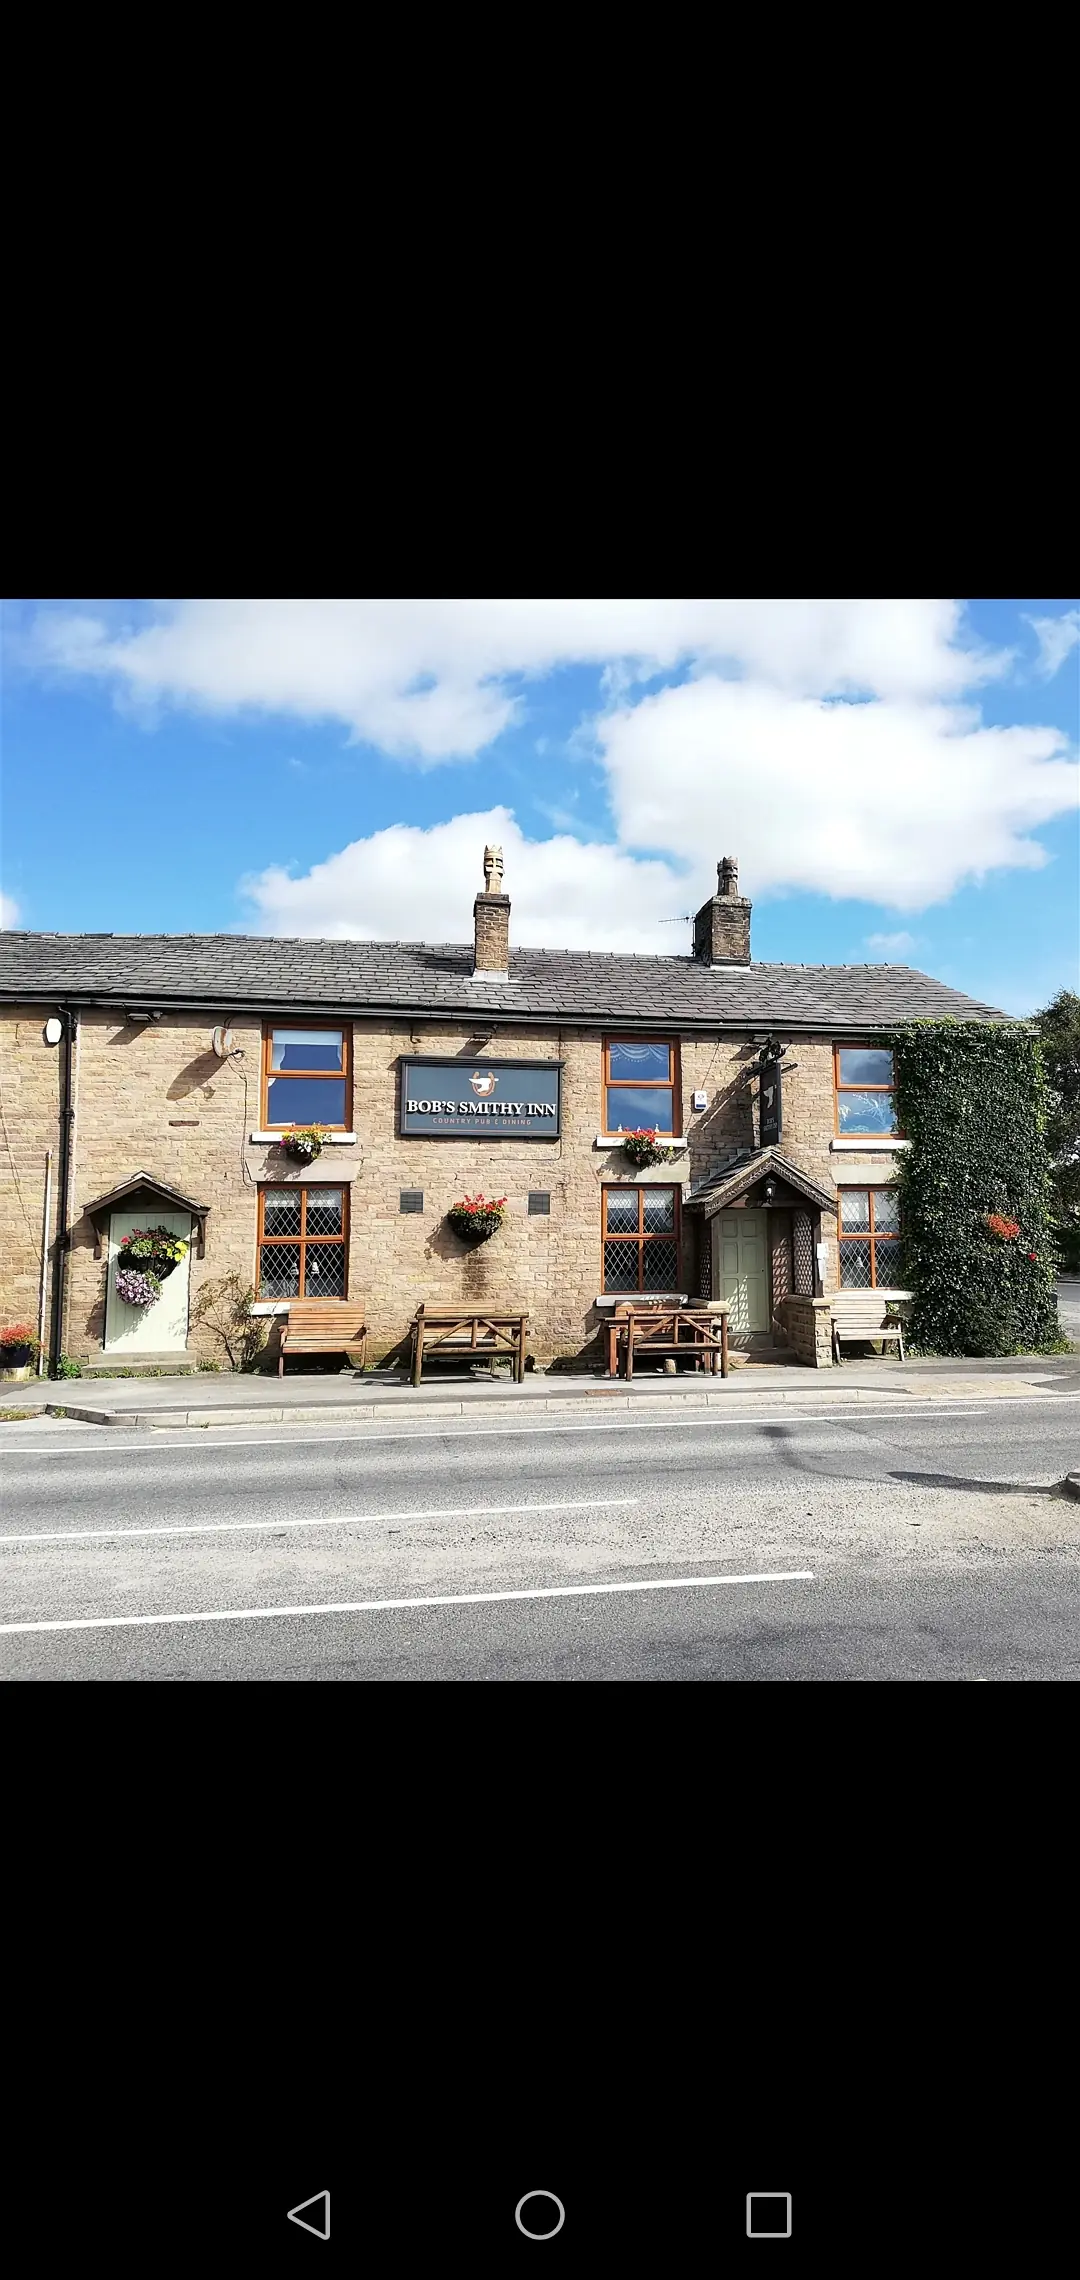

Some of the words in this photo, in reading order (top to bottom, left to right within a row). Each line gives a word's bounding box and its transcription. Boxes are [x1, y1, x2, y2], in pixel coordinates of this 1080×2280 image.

[406, 1100, 456, 1114] BOB'S
[459, 1101, 524, 1116] SMITHY
[527, 1103, 557, 1116] INN
